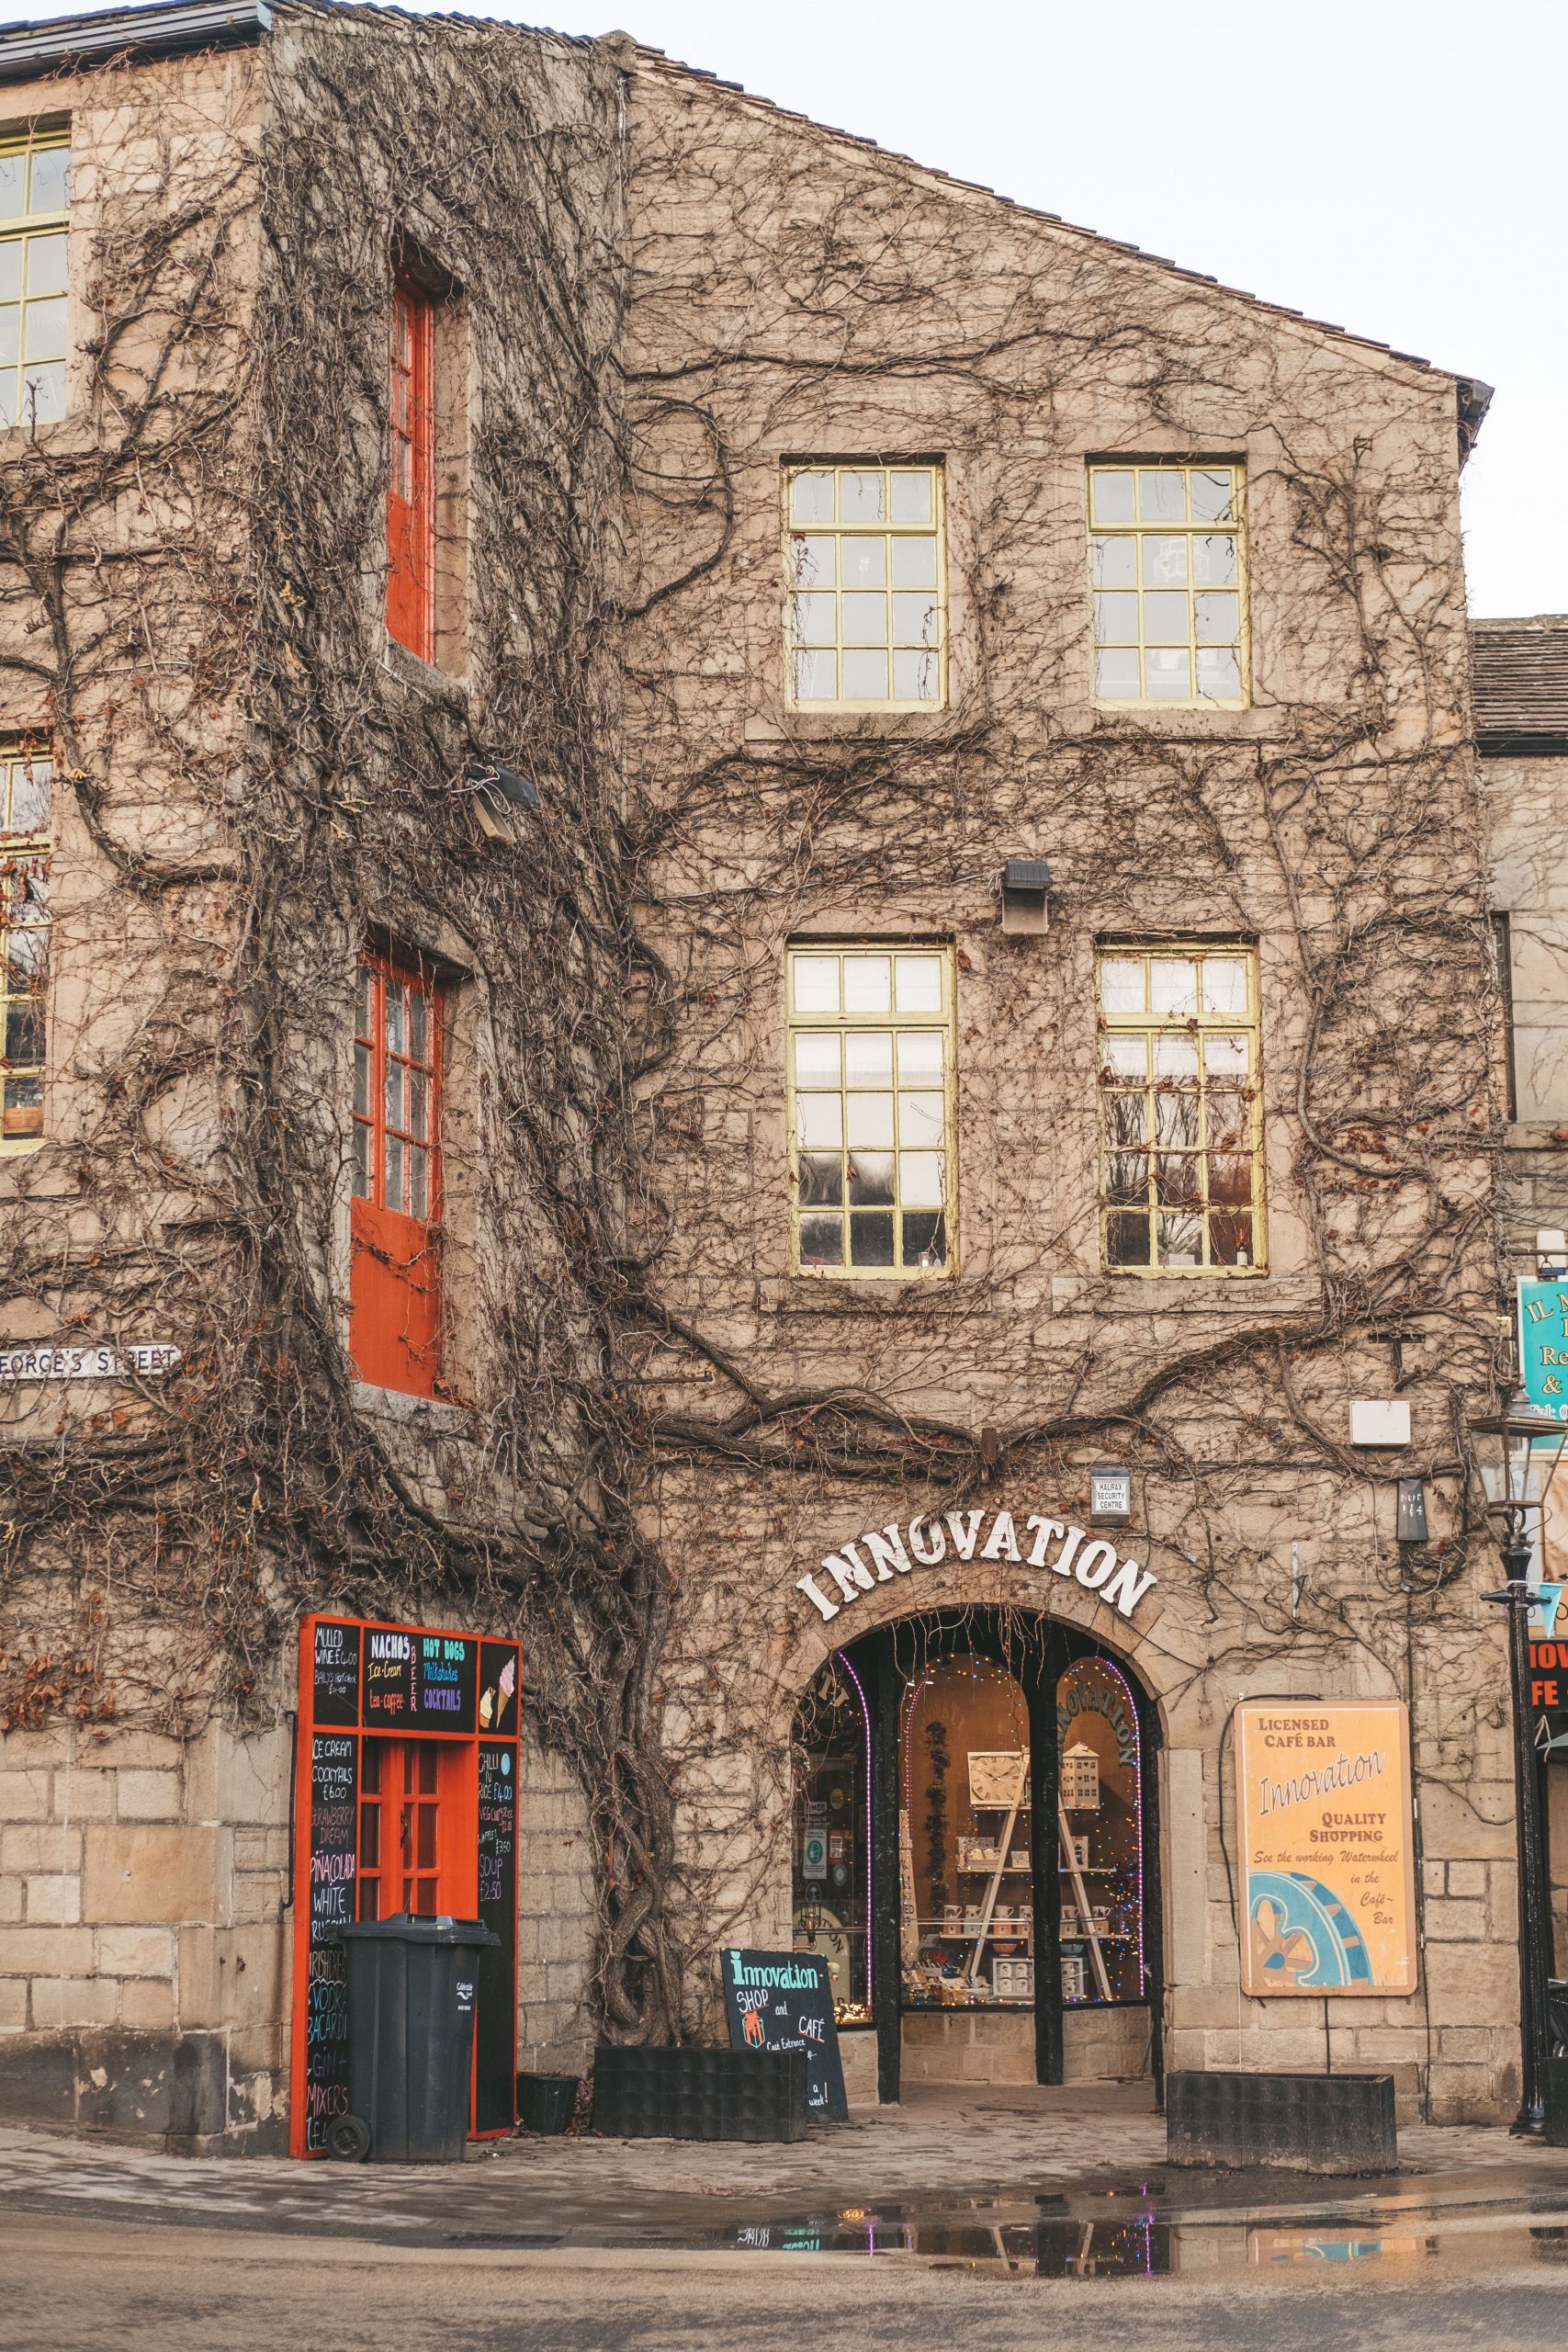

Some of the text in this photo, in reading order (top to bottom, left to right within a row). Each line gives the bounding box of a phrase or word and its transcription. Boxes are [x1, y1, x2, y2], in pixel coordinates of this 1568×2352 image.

[1525, 1299, 1554, 1324] IL
[1097, 1492, 1125, 1500] SECURITY
[1099, 1483, 1122, 1491] HALIFAX
[1100, 1500, 1122, 1509] CENTRE
[796, 1510, 1157, 1622] INNOVATION
[315, 1628, 343, 1647] MULLED
[371, 1634, 411, 1660] NACHOS
[314, 1650, 334, 1665] WINE
[423, 1638, 466, 1661] HOT DOGS
[423, 1661, 458, 1682] Milkshakes
[423, 1688, 461, 1712] COCKTAILS
[1258, 1717, 1330, 1731] LICENSED
[312, 1737, 352, 1760] ICE CREAM
[1264, 1732, 1337, 1748] CAFÉ BAR
[478, 1752, 499, 1773] CHILLI
[311, 1765, 353, 1784] COCKTAILS
[1258, 1748, 1387, 1817] Innovation
[478, 1782, 491, 1800] RICE
[1321, 1813, 1387, 1827] QUALITY
[319, 1827, 349, 1848] DREAM
[1309, 1829, 1383, 1843] SHOPPING
[479, 1853, 502, 1880] SOUP
[1254, 1850, 1398, 1866] See the working Waterwheel
[1350, 1872, 1380, 1884] in the
[1373, 1911, 1393, 1925] Bar
[737, 1989, 769, 2013] SHOP
[774, 2001, 788, 2016] and
[307, 2012, 347, 2045] BACARDI
[798, 2016, 826, 2041] CAFÉ
[781, 2037, 806, 2050] Entrance
